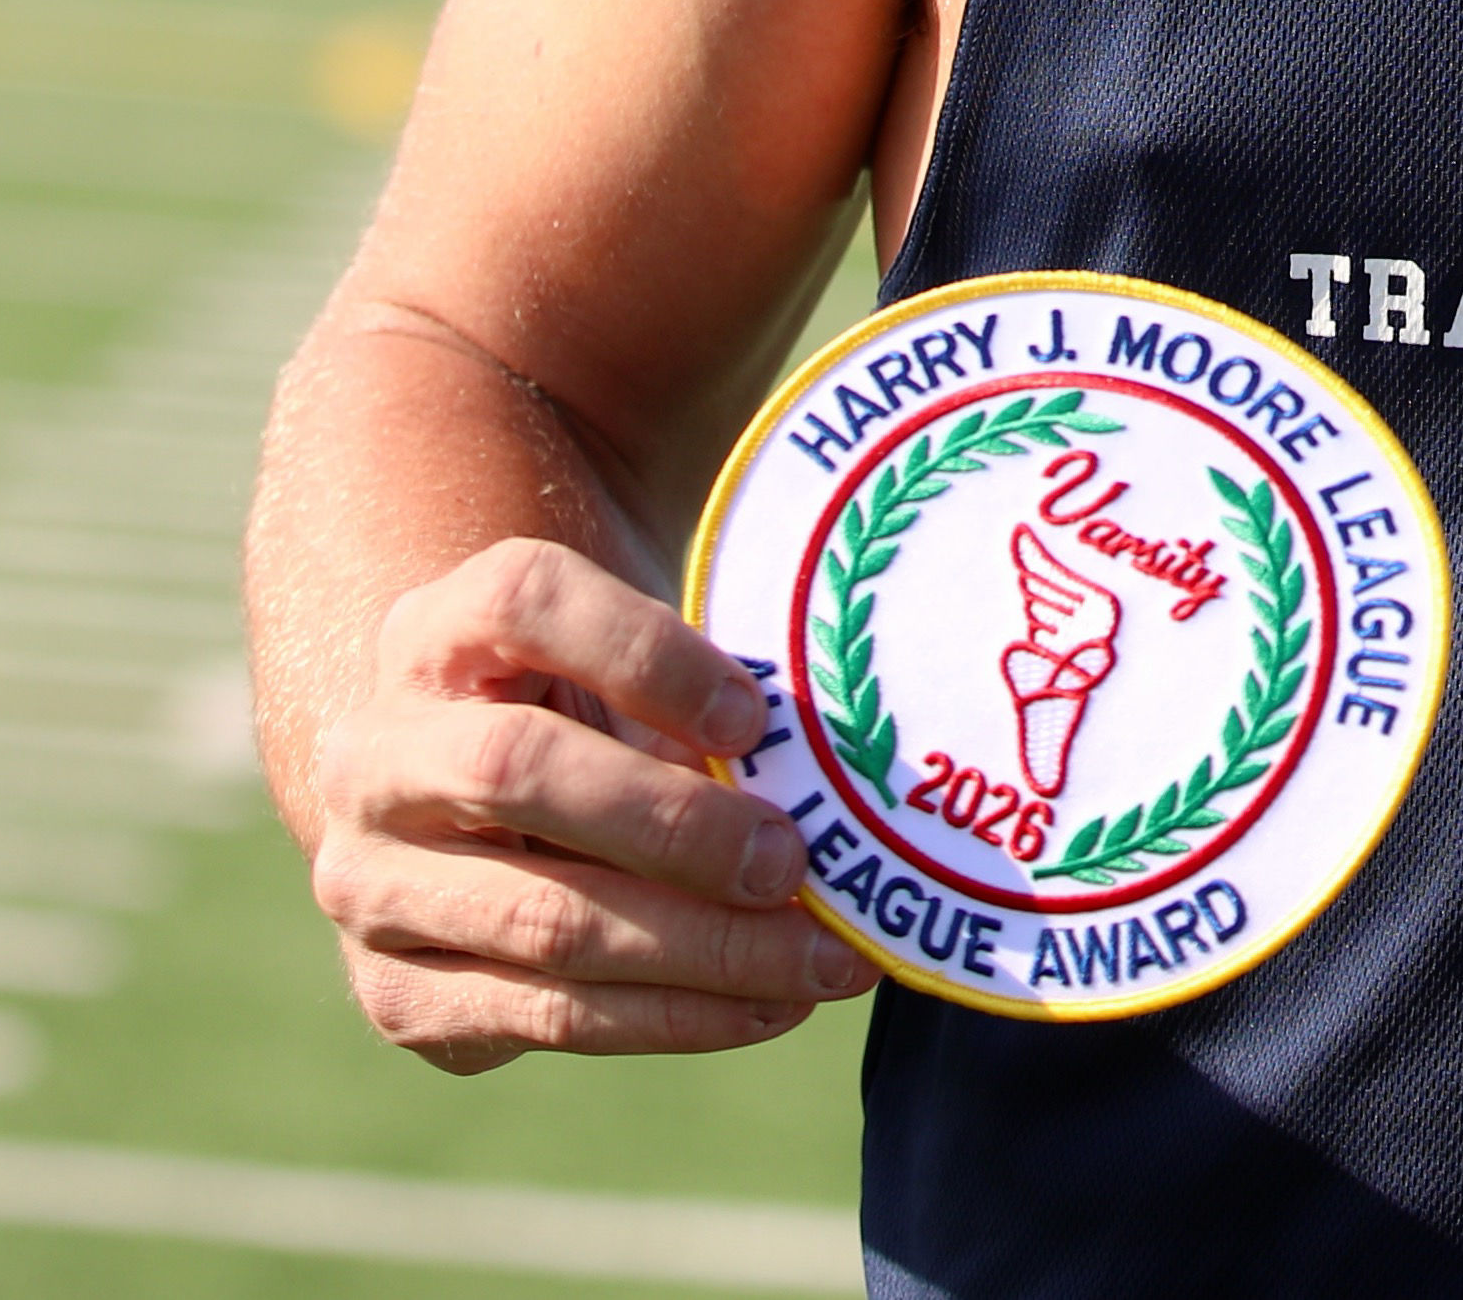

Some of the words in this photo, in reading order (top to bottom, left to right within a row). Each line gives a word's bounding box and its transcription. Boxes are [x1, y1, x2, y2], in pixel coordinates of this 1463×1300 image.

[788, 311, 999, 474] HARRY
[1029, 309, 1077, 362] J.
[1107, 313, 1339, 462] MOORE
[1319, 472, 1414, 737] LEAGUE
[1038, 448, 1228, 622] Varsity
[905, 751, 1053, 862] 2026
[1029, 878, 1248, 989] AWARD
